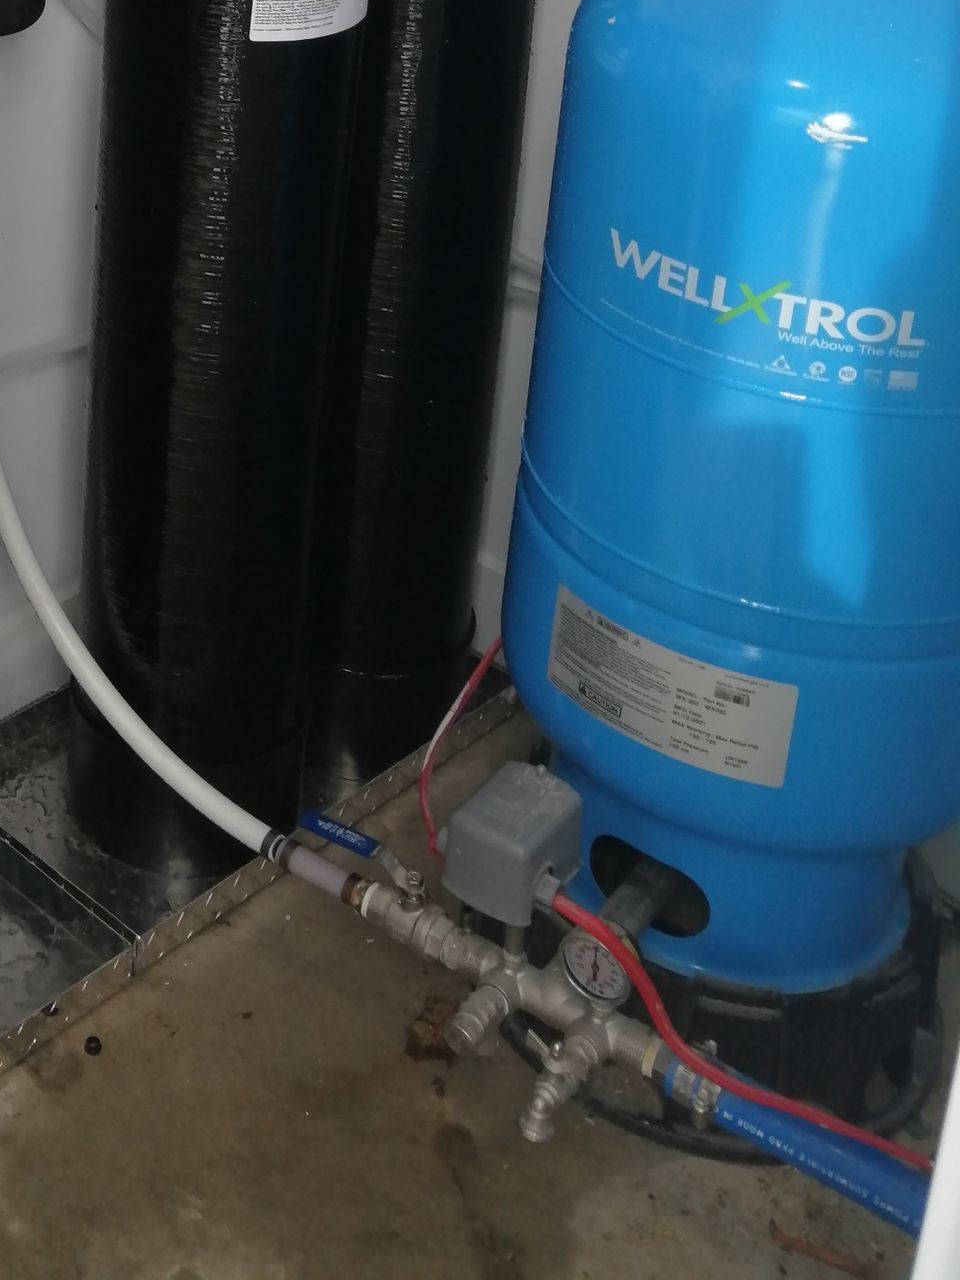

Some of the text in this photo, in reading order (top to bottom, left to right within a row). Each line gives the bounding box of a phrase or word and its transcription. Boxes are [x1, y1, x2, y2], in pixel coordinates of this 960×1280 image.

[778, 329, 920, 360] Well Above The Rest
[840, 369, 856, 378] NSF
[587, 690, 619, 715] CAUTION
